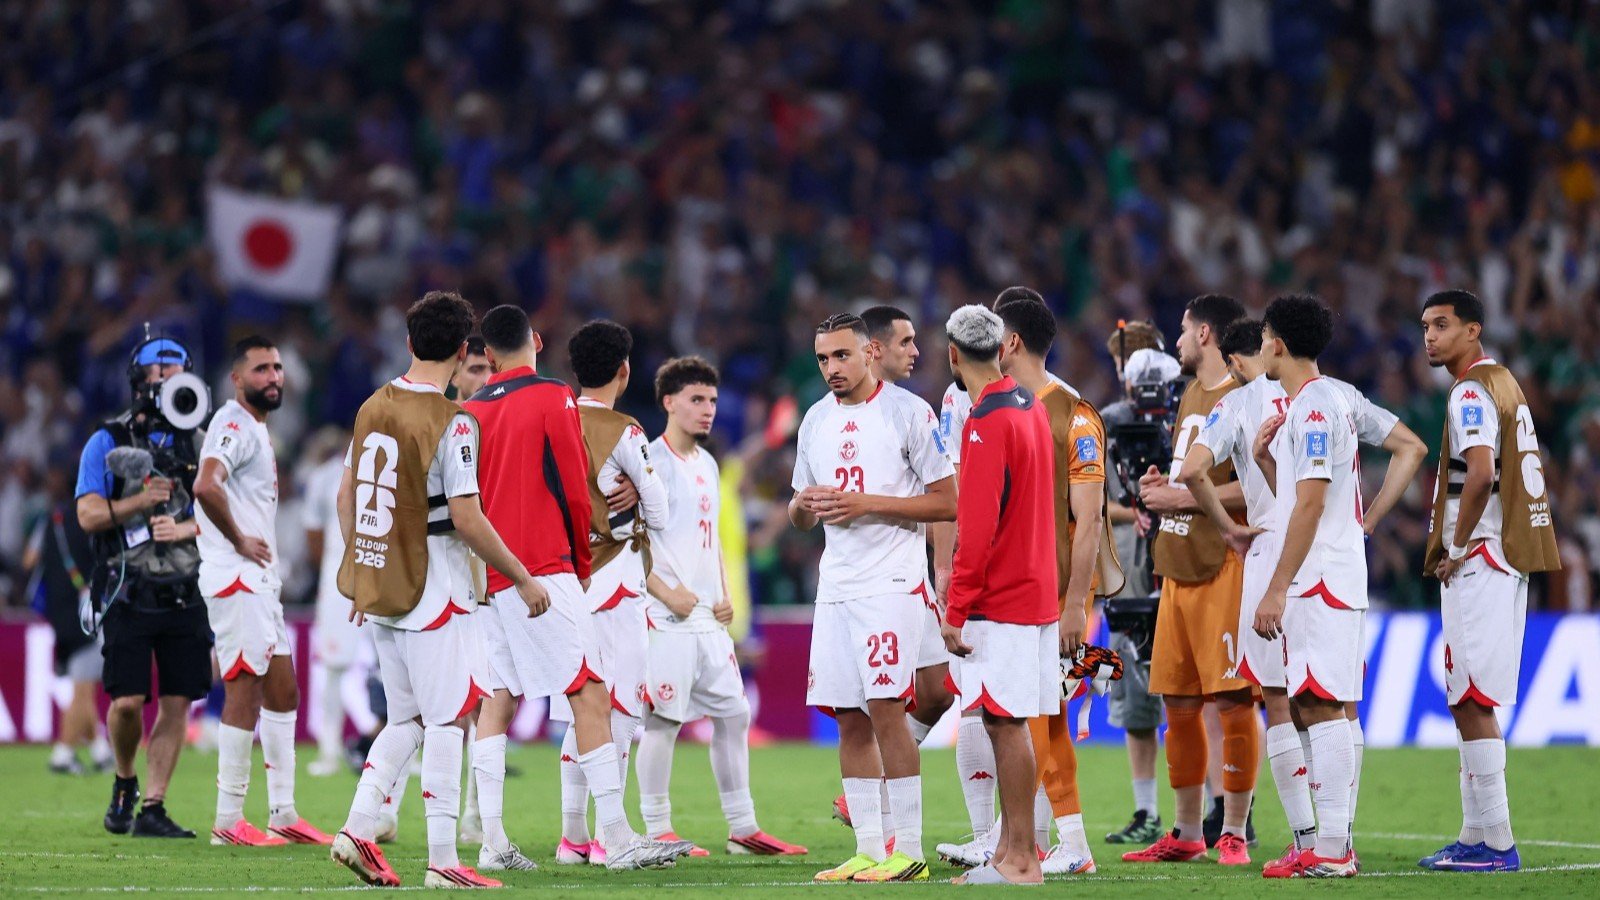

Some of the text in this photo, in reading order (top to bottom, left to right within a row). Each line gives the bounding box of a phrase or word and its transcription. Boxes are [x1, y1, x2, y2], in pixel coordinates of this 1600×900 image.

[835, 466, 864, 493] 23
[360, 513, 378, 527] FIFA
[867, 631, 899, 667] 23
